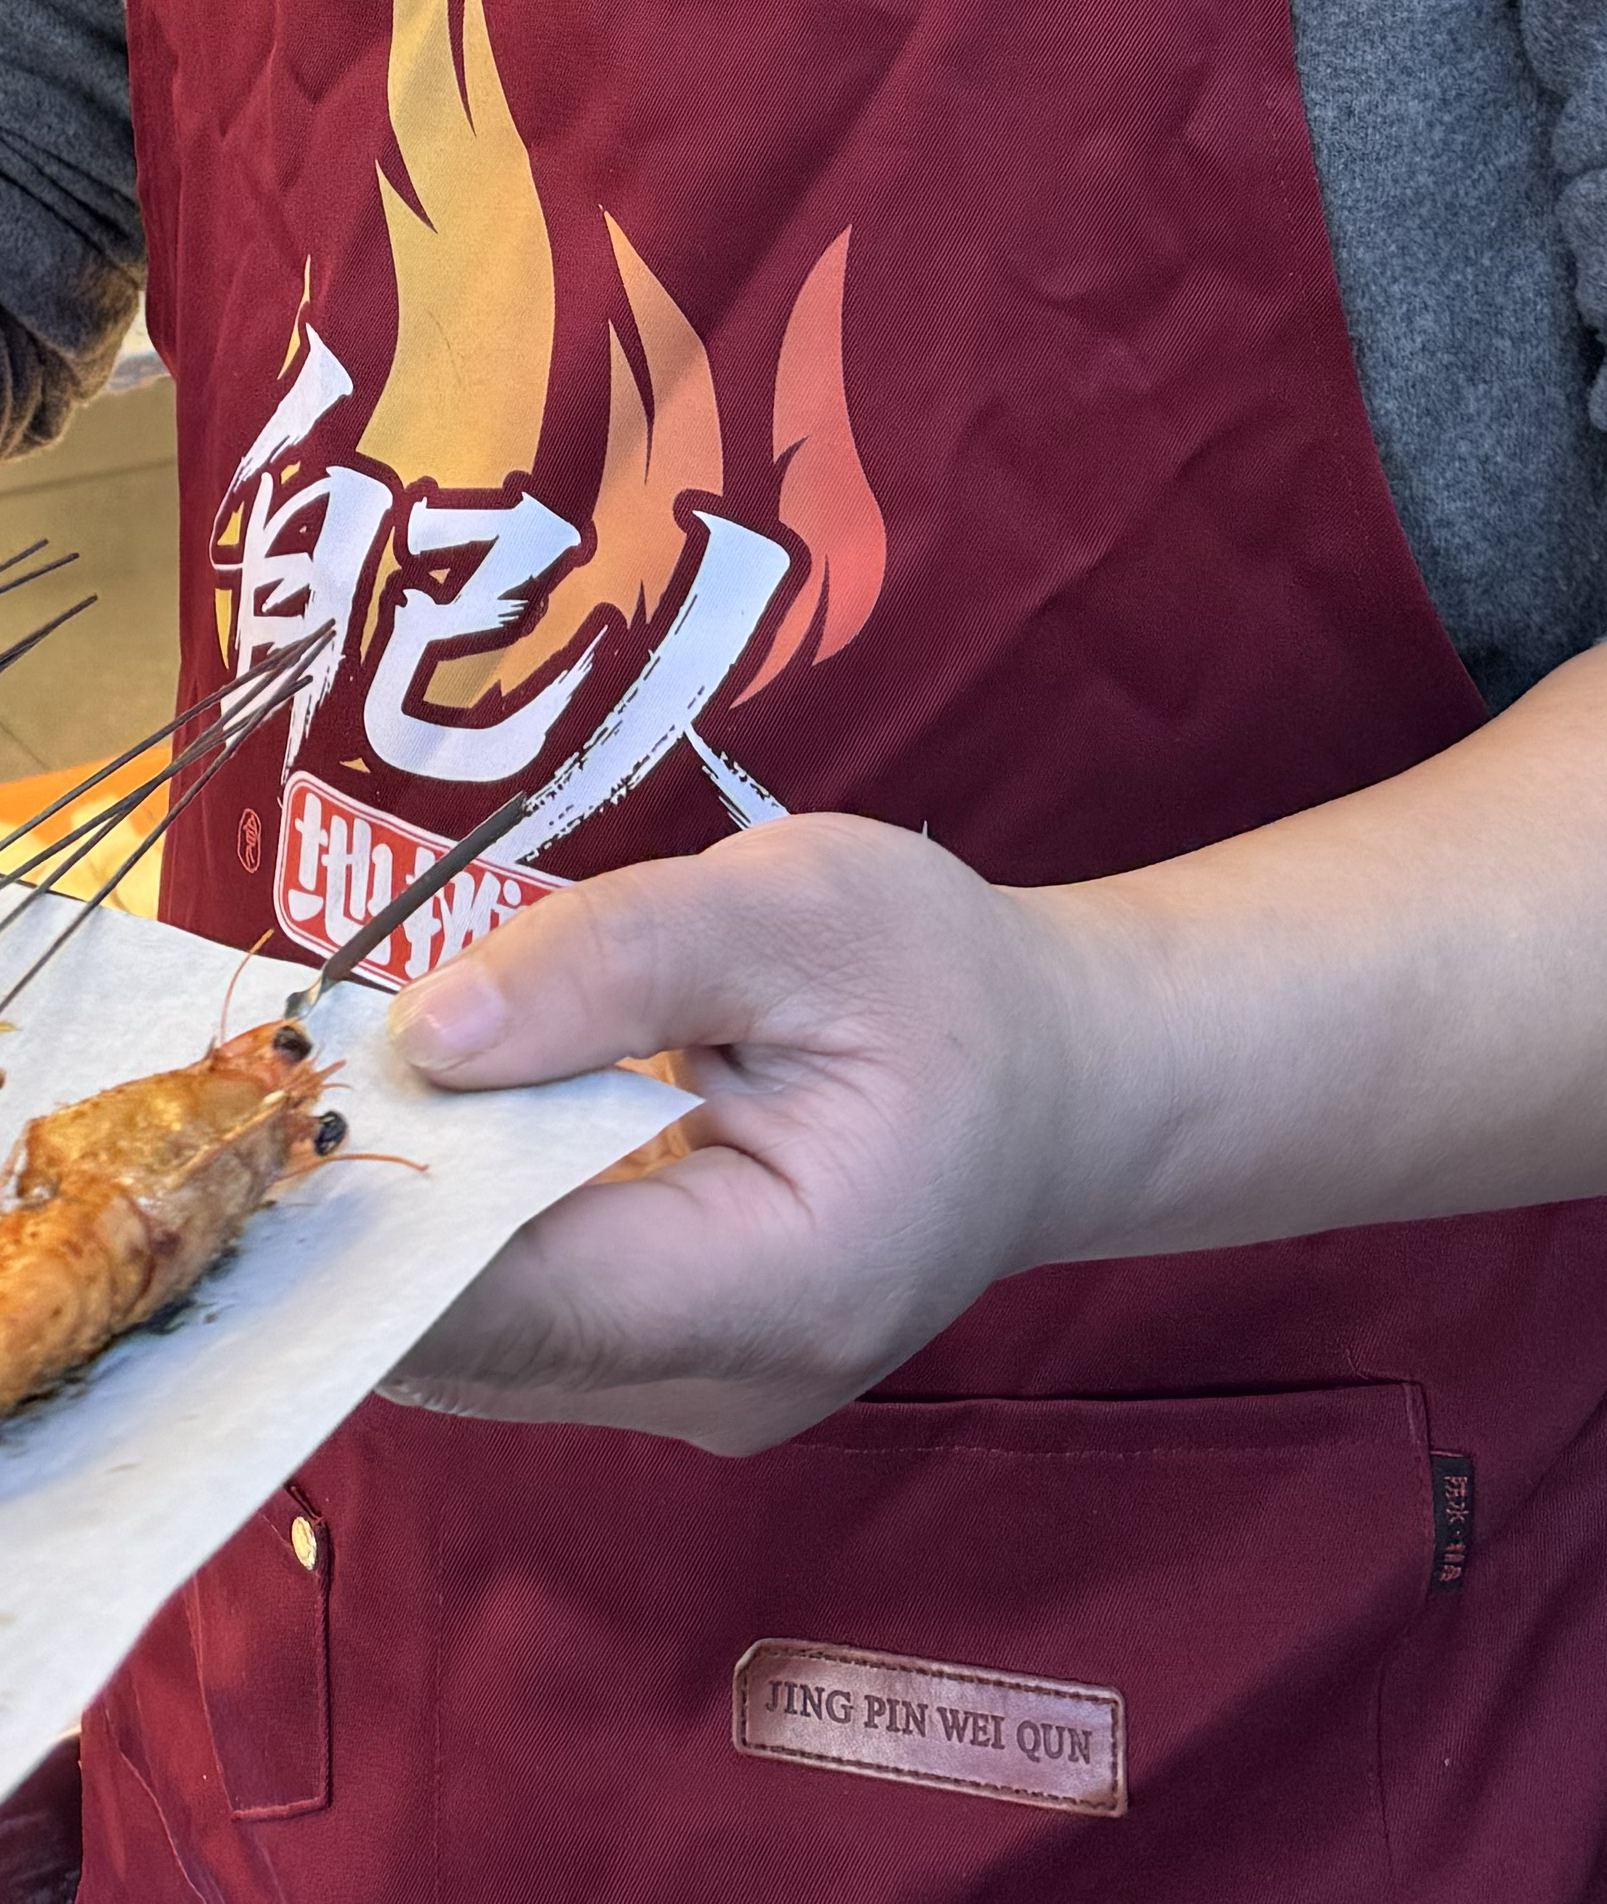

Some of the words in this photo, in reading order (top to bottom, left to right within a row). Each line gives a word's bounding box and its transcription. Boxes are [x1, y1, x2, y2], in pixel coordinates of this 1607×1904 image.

[765, 1679, 854, 1724] JING
[863, 1694, 929, 1738] PIN
[935, 1705, 1005, 1750] WEI
[1016, 1720, 1092, 1765] QUN
